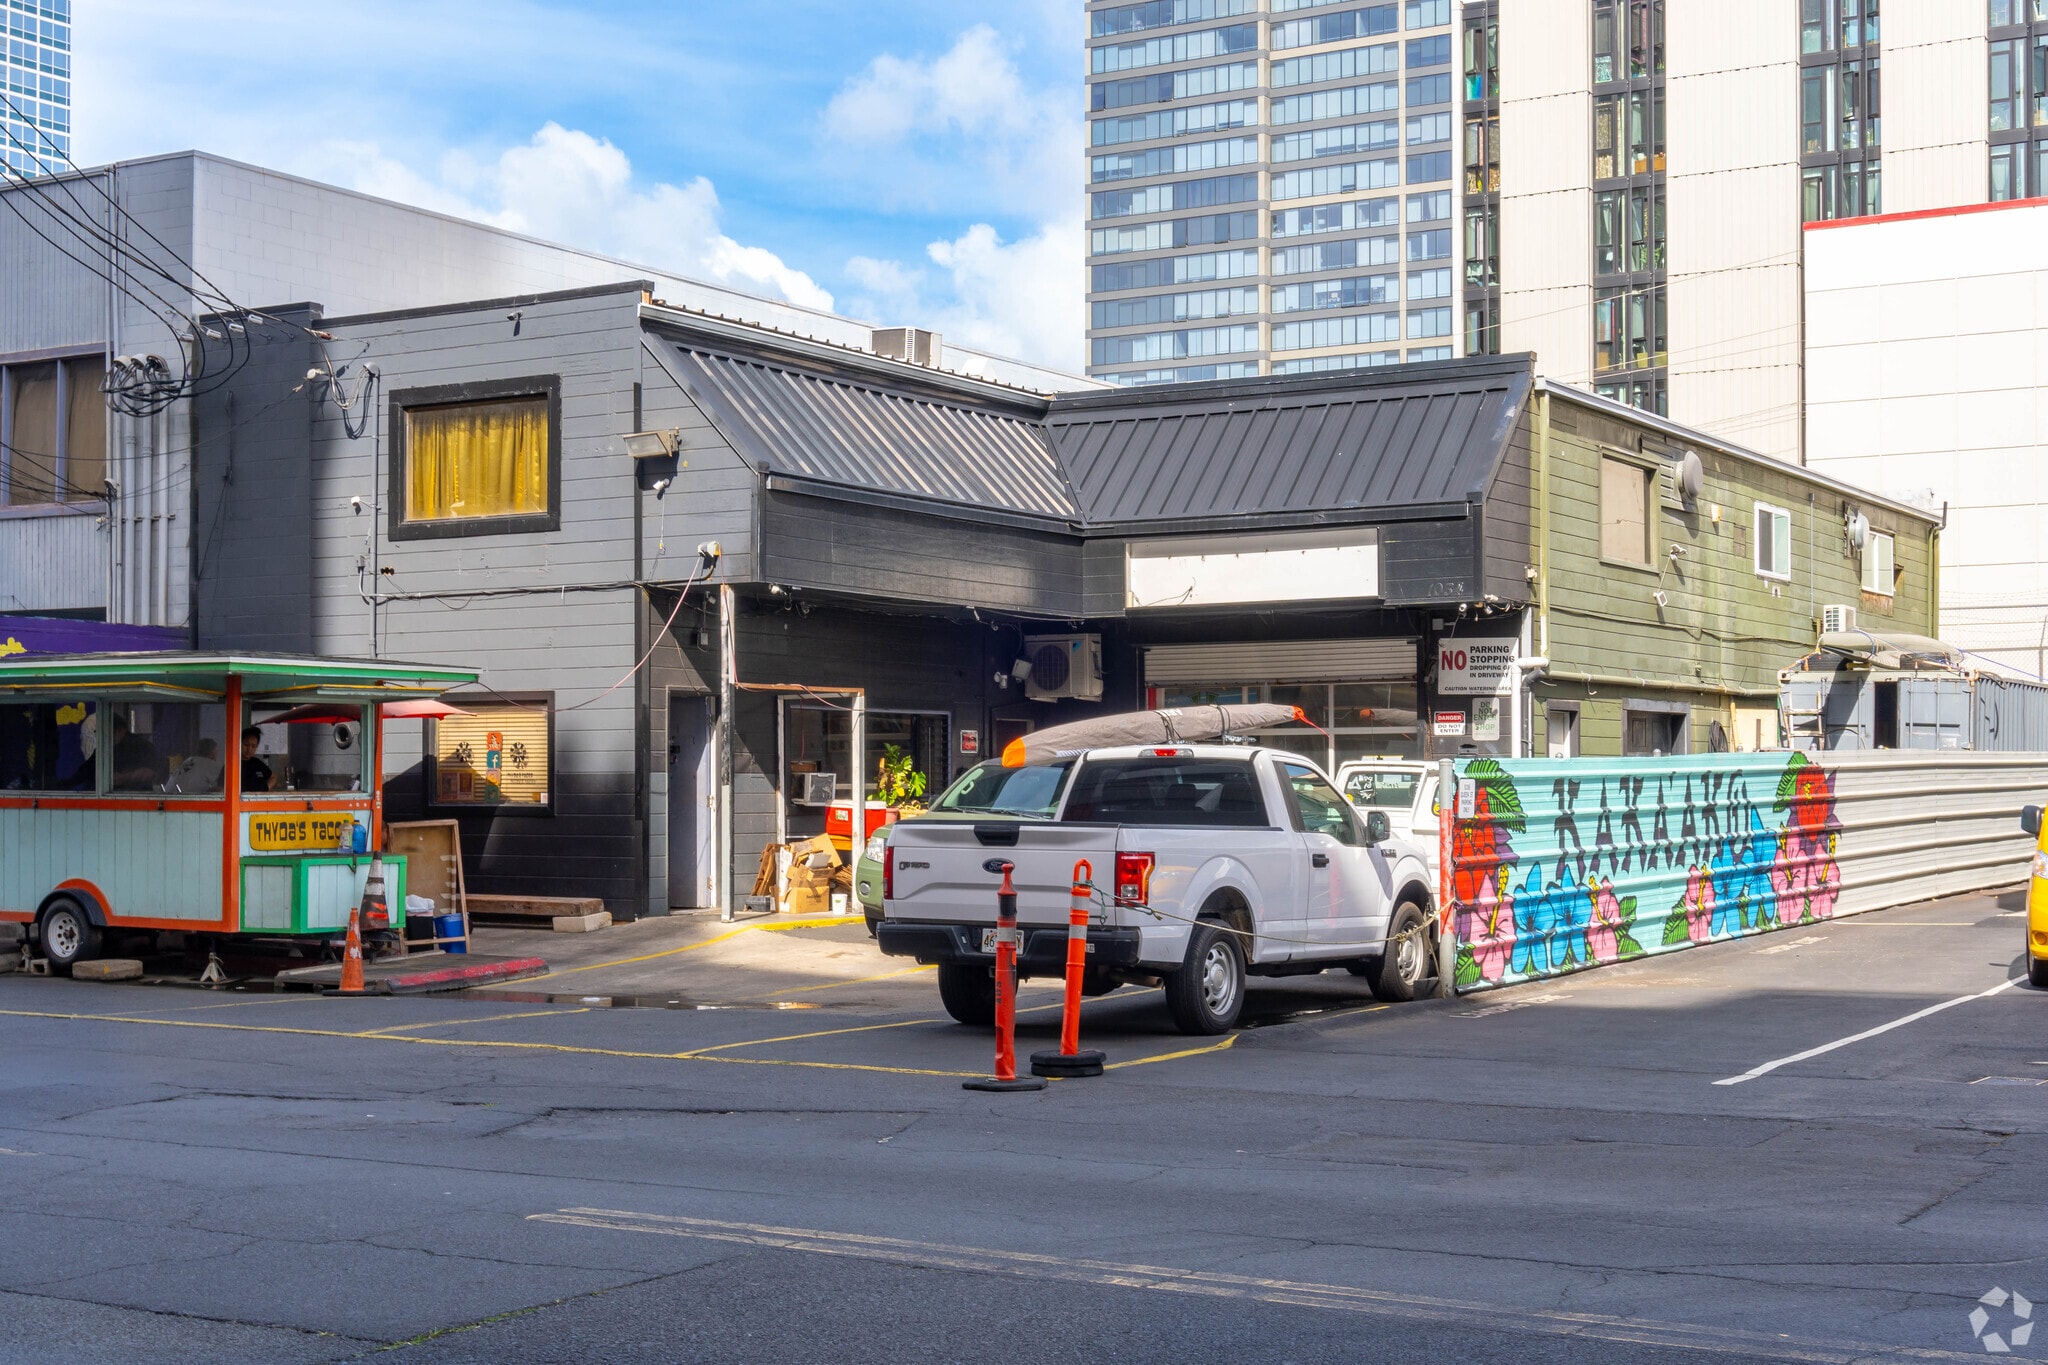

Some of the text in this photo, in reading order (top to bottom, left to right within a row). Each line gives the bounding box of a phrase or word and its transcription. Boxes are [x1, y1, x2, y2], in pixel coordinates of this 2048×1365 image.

[1469, 645, 1510, 653] PARKING
[1441, 650, 1467, 671] NO
[1469, 655, 1515, 663] STOPPING
